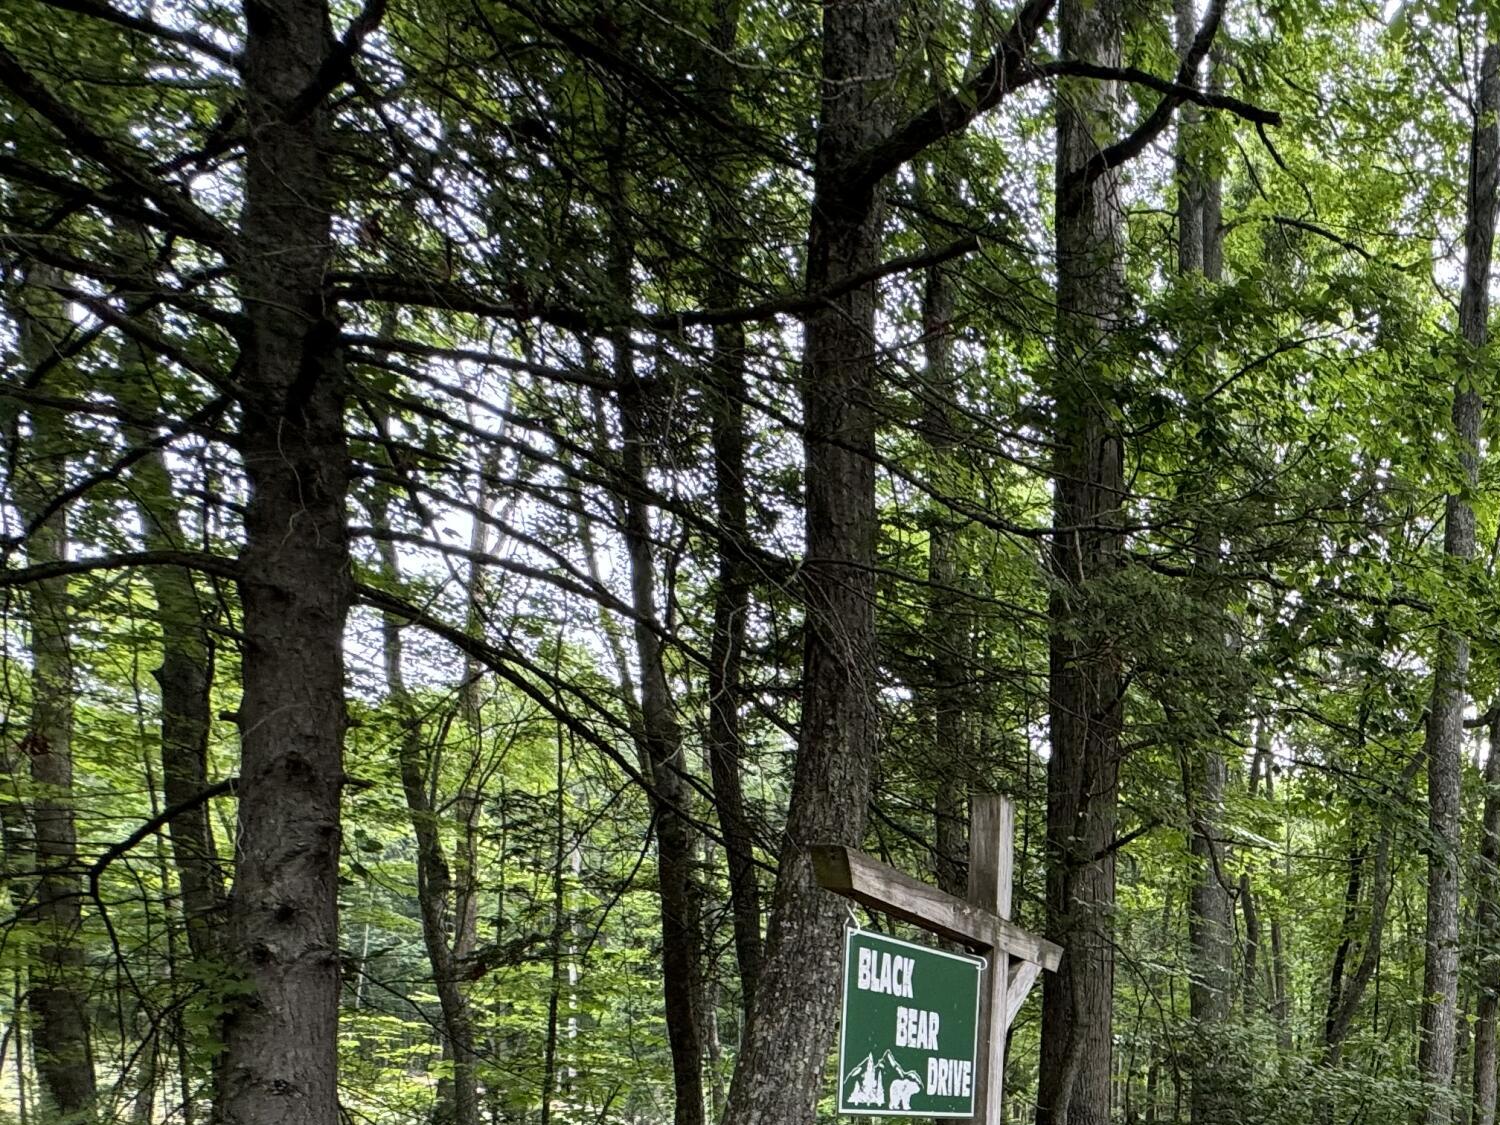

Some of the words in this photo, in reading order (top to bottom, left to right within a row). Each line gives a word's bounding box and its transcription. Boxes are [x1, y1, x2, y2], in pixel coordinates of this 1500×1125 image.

[858, 947, 915, 998] BLACK
[895, 1006, 940, 1050] BEAR
[926, 1057, 972, 1097] DRIVE
